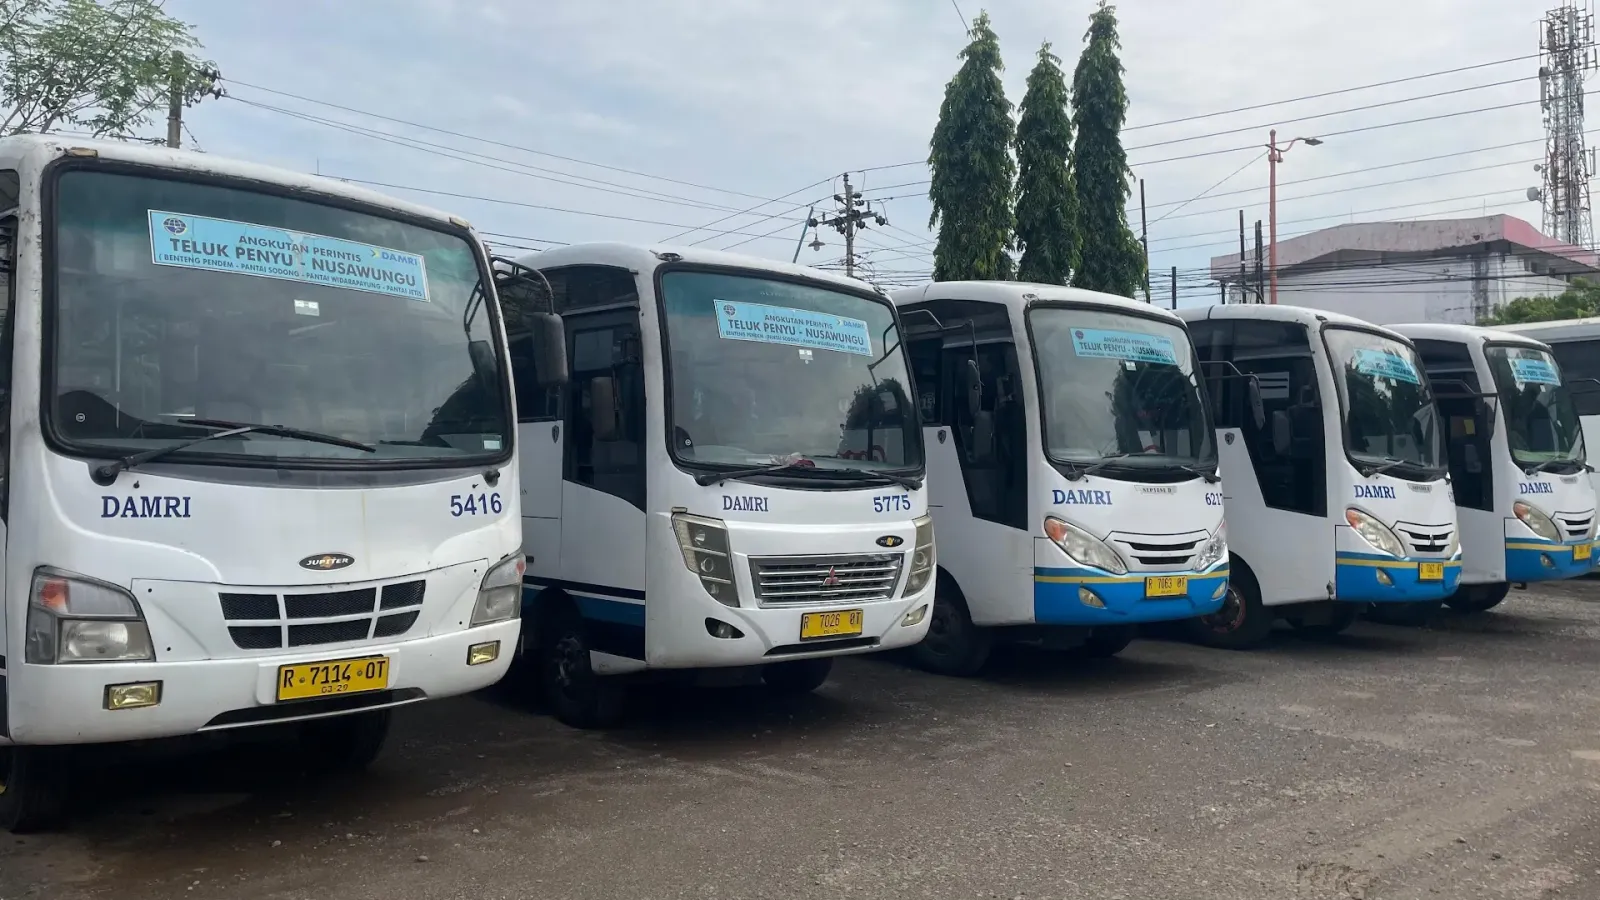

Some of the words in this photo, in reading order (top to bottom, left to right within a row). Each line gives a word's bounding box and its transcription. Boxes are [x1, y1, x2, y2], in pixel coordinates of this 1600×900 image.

[239, 235, 309, 254] ANGKUTAN
[313, 246, 362, 263] PERINTIS
[170, 238, 229, 258] TELUK
[235, 246, 293, 267] PENYU
[312, 257, 416, 287] NUSAWUNGU
[381, 251, 418, 266] DAMRI
[164, 254, 201, 264] BENTENG
[203, 258, 234, 268] PENDEM
[241, 263, 267, 273] PANTAI
[268, 267, 299, 277] SODONG
[306, 273, 330, 282] PANTAI
[764, 314, 804, 325] ANGKUTAN
[805, 319, 833, 330] PERINTIS
[728, 319, 761, 332] TELUK
[763, 322, 796, 336] PENYU
[805, 328, 864, 346] NUSAWUNGU
[1079, 341, 1102, 351] TELUK
[1103, 343, 1127, 353] PENYU
[1354, 484, 1396, 499] DAMRI
[1519, 482, 1553, 494] DAMRI
[450, 492, 503, 517] 5416
[722, 495, 769, 512] DAMRI
[873, 494, 911, 513] 5775
[1052, 489, 1113, 505] DAMRI
[101, 496, 191, 518] DAMRI
[305, 556, 349, 567] JUPITER
[1148, 578, 1152, 589] R
[804, 615, 809, 630] R
[820, 613, 841, 628] 7026
[283, 669, 294, 688] R
[310, 664, 351, 685] 7114
